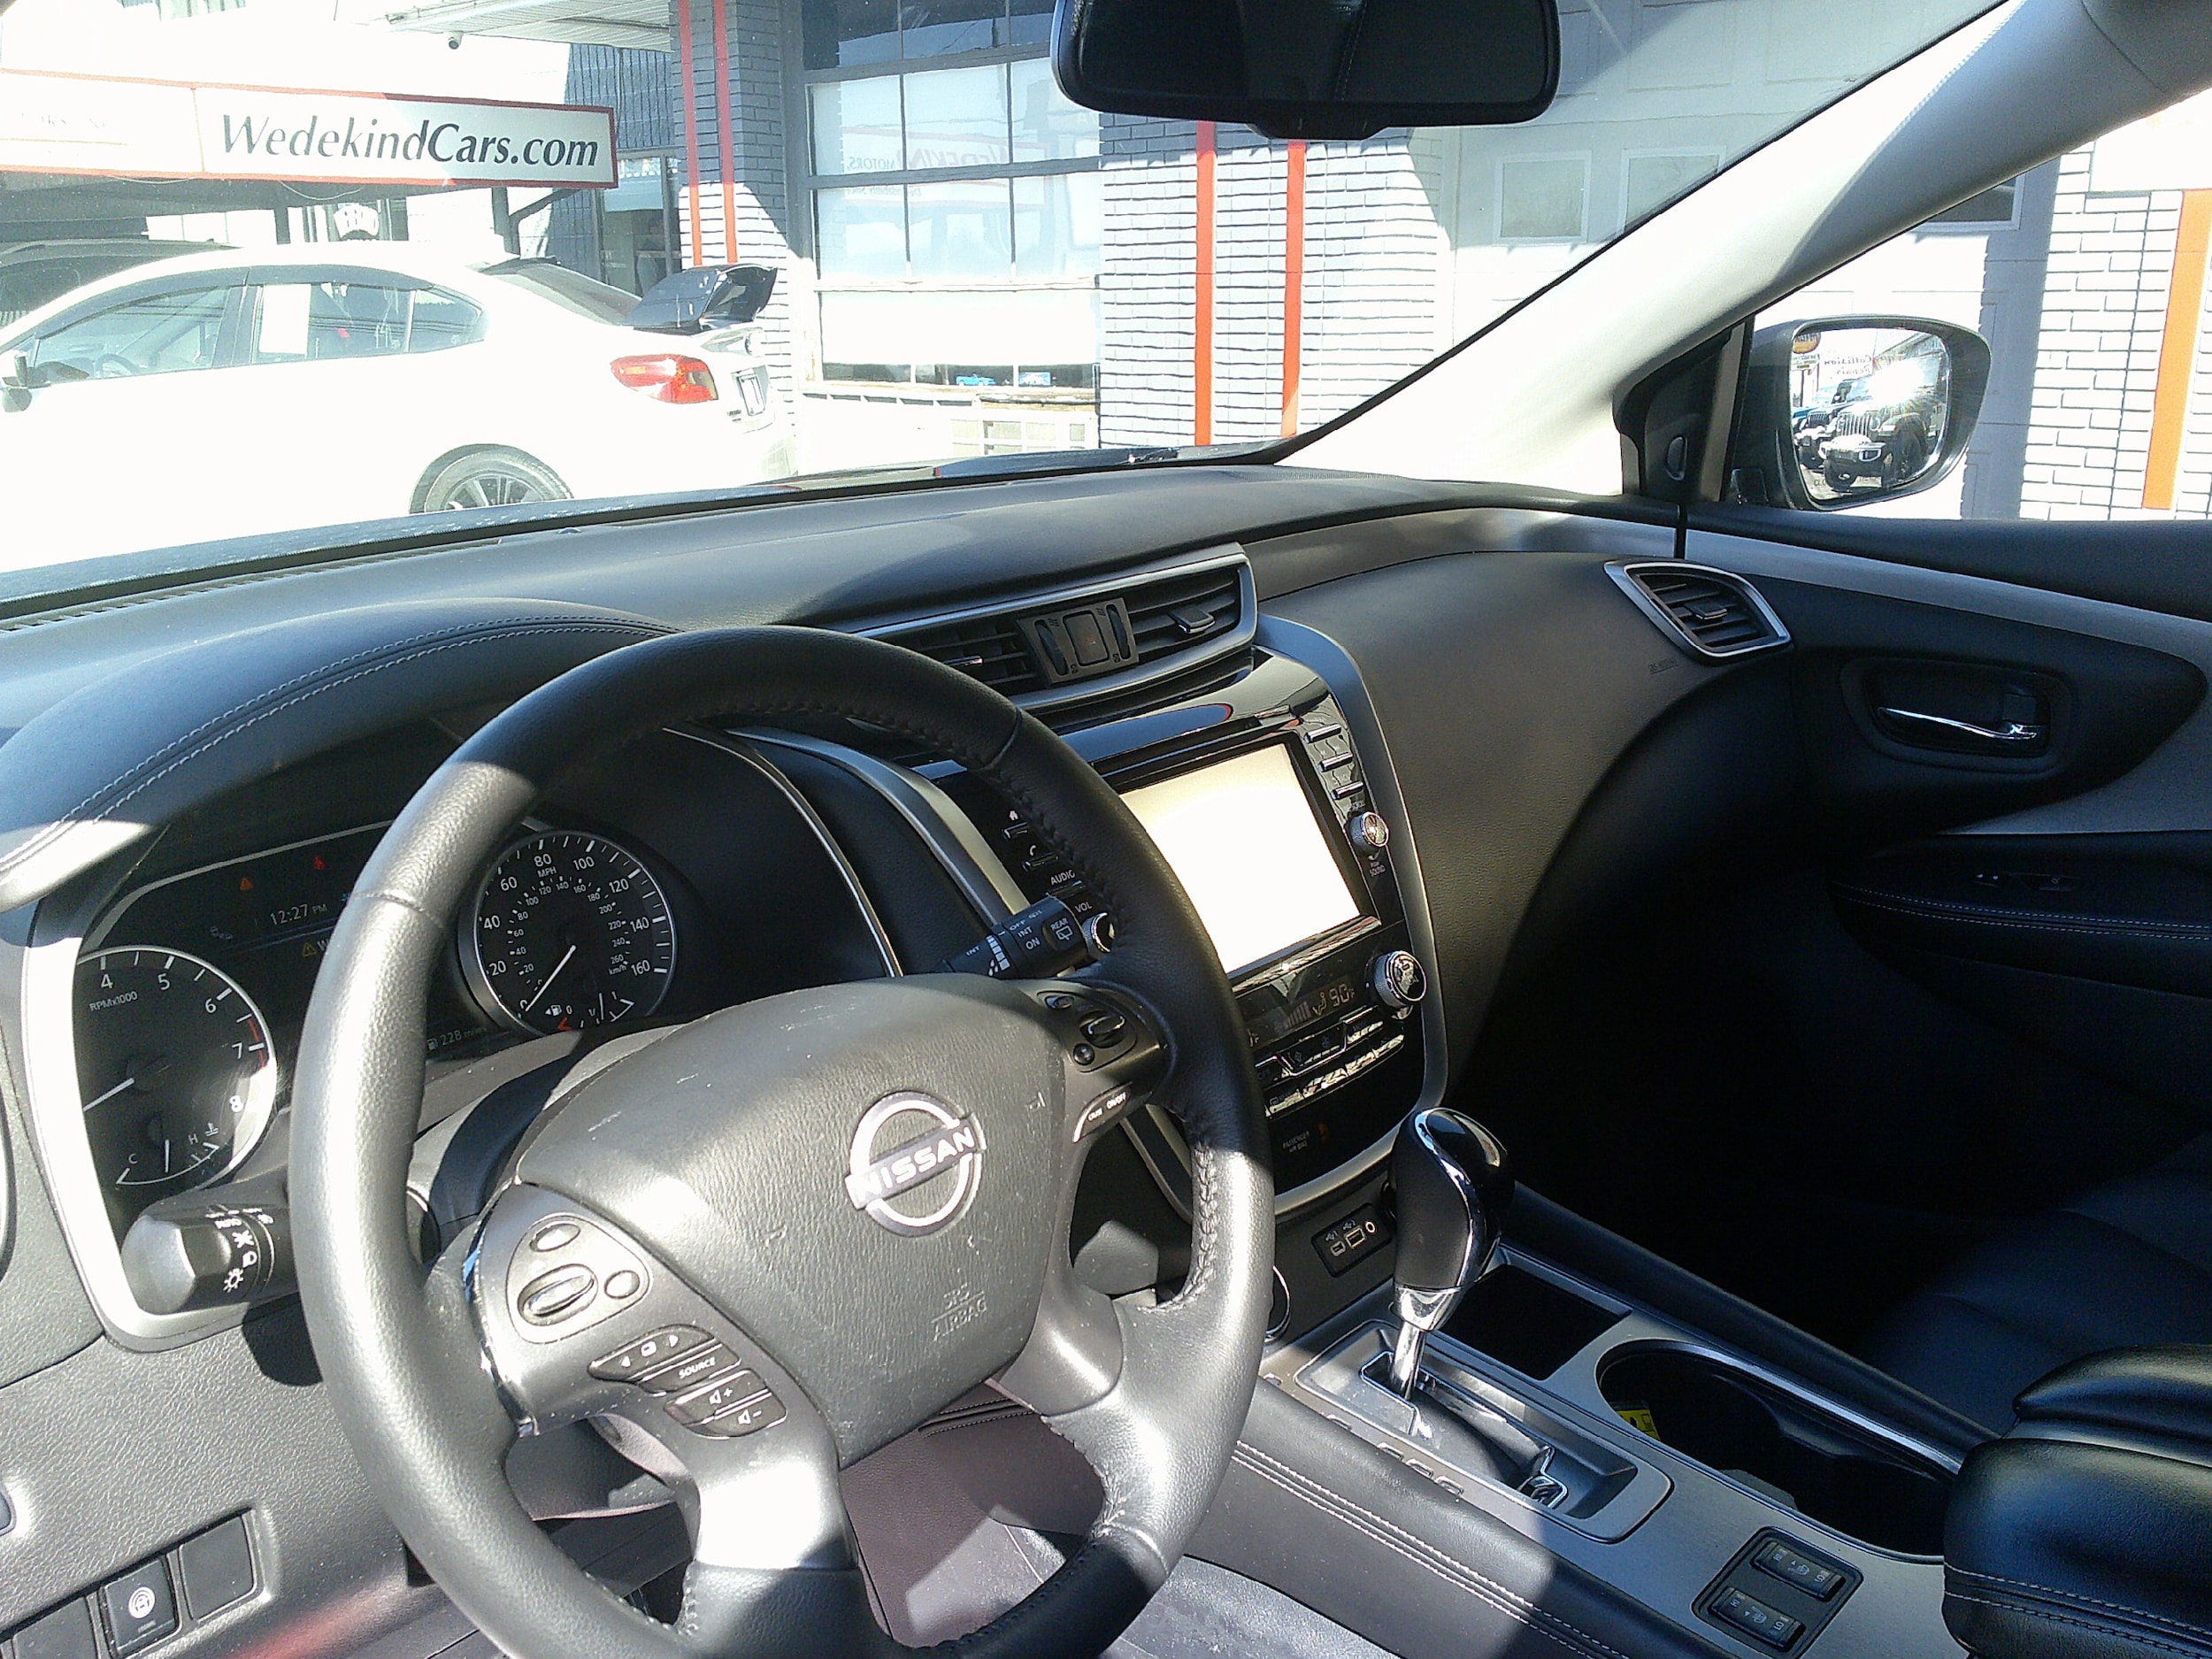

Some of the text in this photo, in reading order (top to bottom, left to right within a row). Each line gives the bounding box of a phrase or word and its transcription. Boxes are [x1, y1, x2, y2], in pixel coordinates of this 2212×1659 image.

[222, 113, 599, 167] WedekindCars.com
[534, 853, 552, 867] 80
[573, 856, 595, 871] 100
[537, 866, 557, 879] MPH
[500, 876, 518, 892] 60
[556, 881, 569, 892] 140
[573, 884, 586, 895] 160
[609, 878, 629, 894] 120
[539, 886, 552, 895] 120
[526, 896, 540, 906] 100
[587, 892, 601, 902] 180
[599, 903, 613, 914] 200
[1074, 902, 1093, 913] VOL
[270, 902, 327, 926] 12:27 PM
[517, 911, 529, 921] 80
[484, 915, 501, 931] 40
[608, 919, 621, 930] 220
[629, 917, 649, 933] 140
[1050, 918, 1069, 930] REAR
[513, 929, 525, 938] 60
[1018, 926, 1033, 938] INT
[611, 937, 626, 948] 240
[1025, 938, 1041, 950] ON
[516, 946, 527, 956] 40
[965, 946, 980, 956] INT
[611, 954, 624, 964] 260
[488, 960, 507, 976] 20
[524, 963, 534, 972] 20
[631, 959, 650, 976] 160
[100, 974, 113, 989] 4
[157, 972, 171, 991] 5
[204, 998, 217, 1014] 6
[566, 1005, 572, 1015] 0
[441, 1030, 462, 1046] 228
[232, 1042, 243, 1059] 7
[229, 1095, 243, 1113] 8
[188, 1133, 198, 1145] H
[128, 1153, 138, 1164] C
[856, 1127, 975, 1201] NISSAN
[933, 1297, 987, 1341] AIRBAG
[678, 1356, 716, 1379] SOURCE
[1772, 1553, 1783, 1562] HI
[1730, 1599, 1740, 1608] HI
[1773, 1621, 1785, 1632] LO
